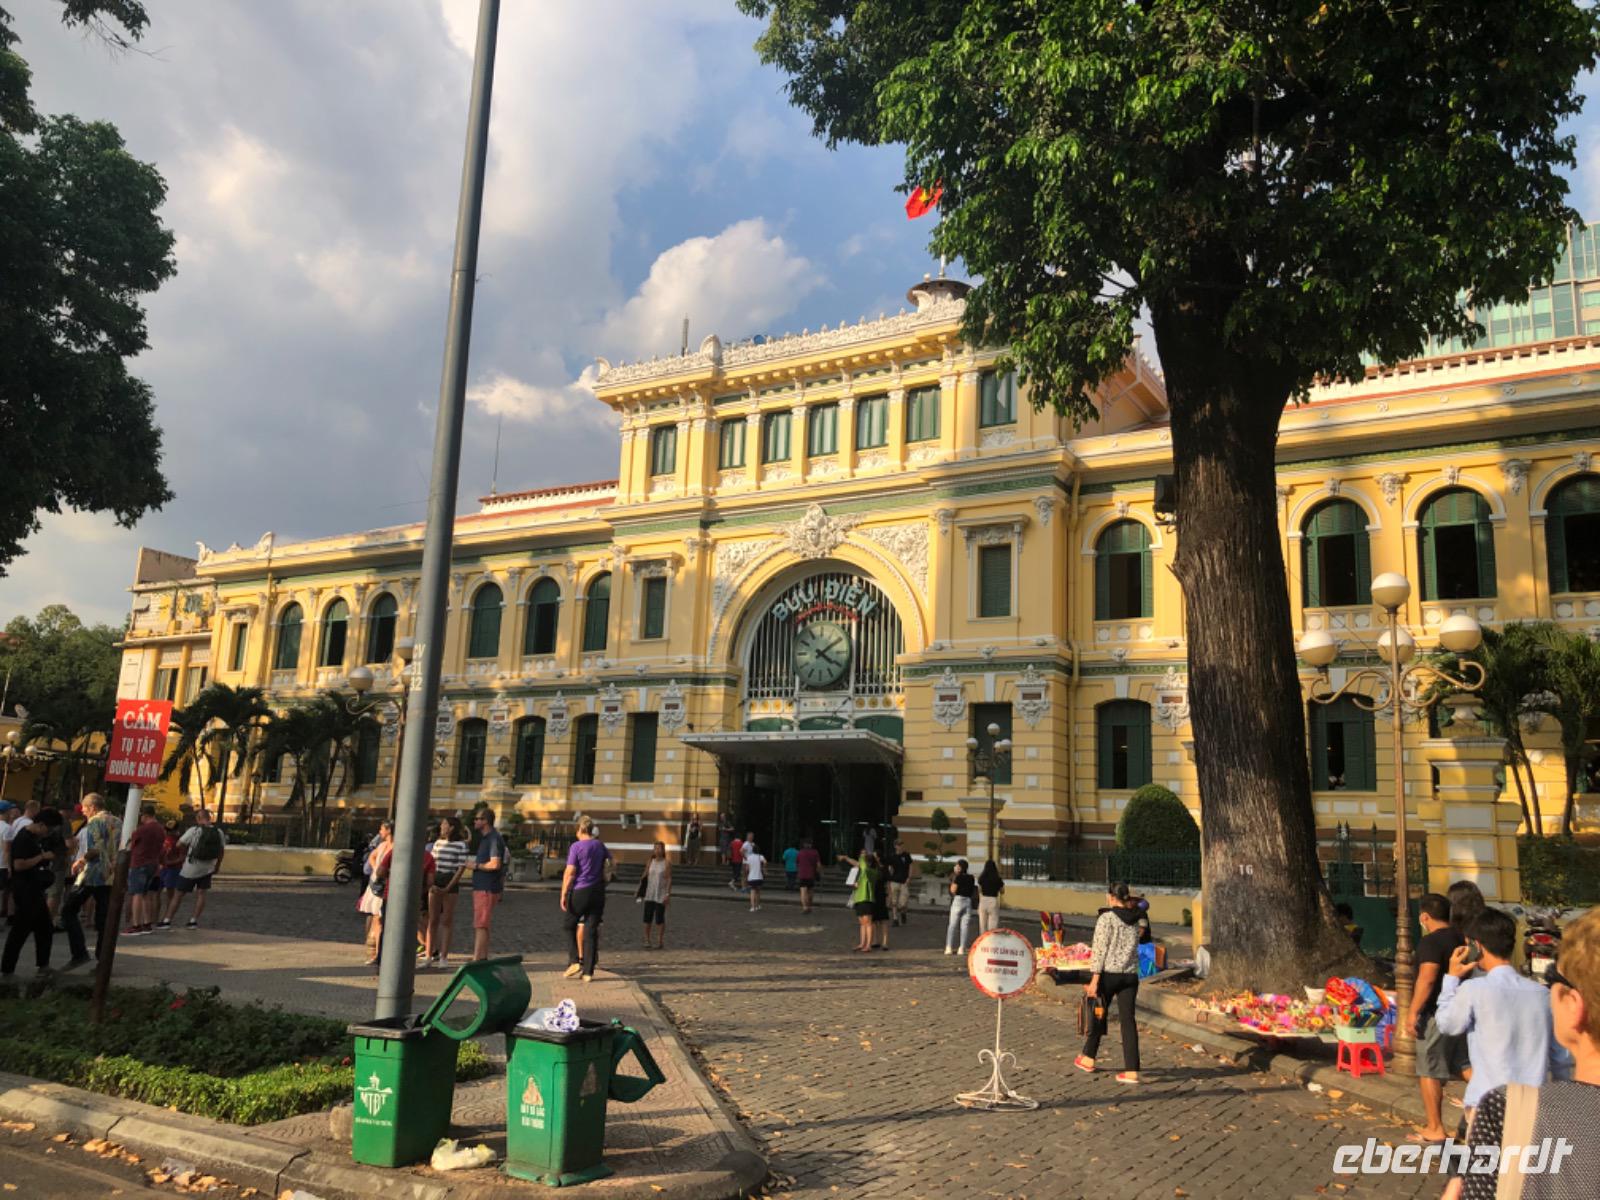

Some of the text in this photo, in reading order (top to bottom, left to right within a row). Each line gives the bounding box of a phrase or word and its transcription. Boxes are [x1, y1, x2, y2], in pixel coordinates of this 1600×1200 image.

[123, 703, 162, 730] CẤM
[121, 736, 156, 757] TỤ TẬP
[138, 760, 159, 777] BÁN
